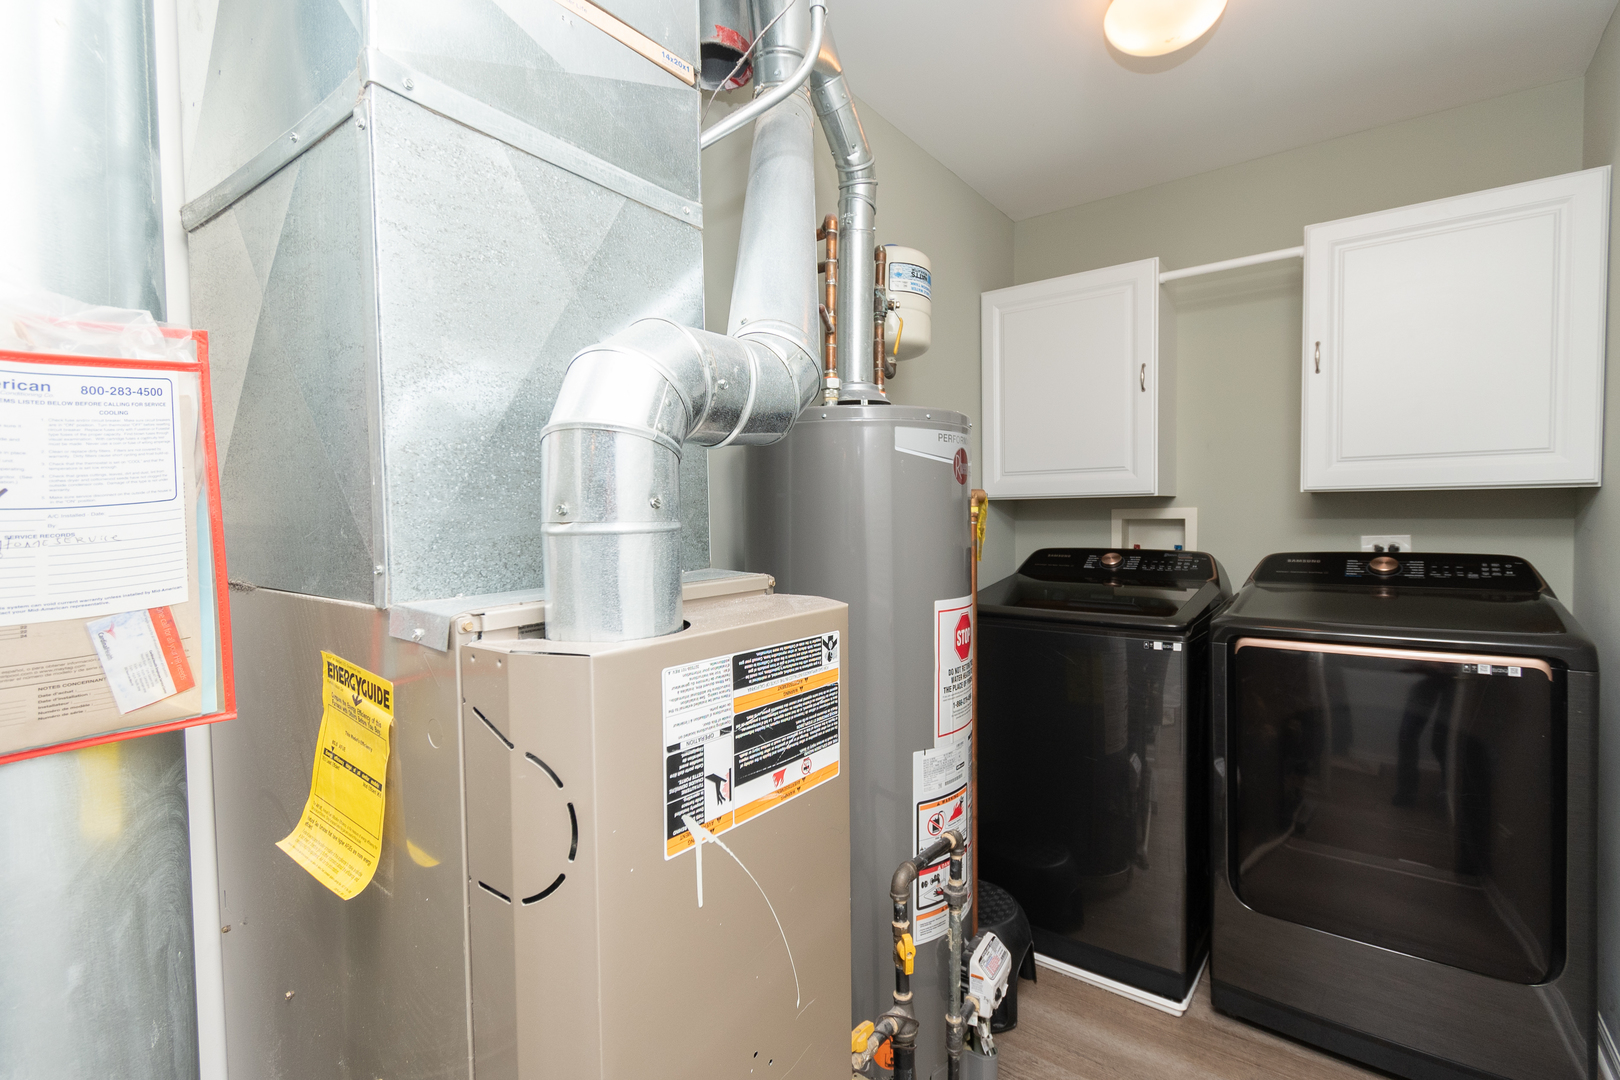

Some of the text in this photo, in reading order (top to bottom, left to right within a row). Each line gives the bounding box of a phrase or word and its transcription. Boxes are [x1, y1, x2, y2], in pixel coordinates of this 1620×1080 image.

[661, 51, 690, 72] 14x20x1
[0, 379, 50, 392] rican
[81, 386, 163, 396] 800-283-4500
[160, 618, 169, 628] call
[956, 628, 970, 647] STOP
[168, 643, 178, 656] your
[174, 655, 182, 664] HR
[176, 664, 187, 680] needs
[327, 661, 390, 709] ENERGYGUIDE
[686, 733, 713, 745] OPERATION
